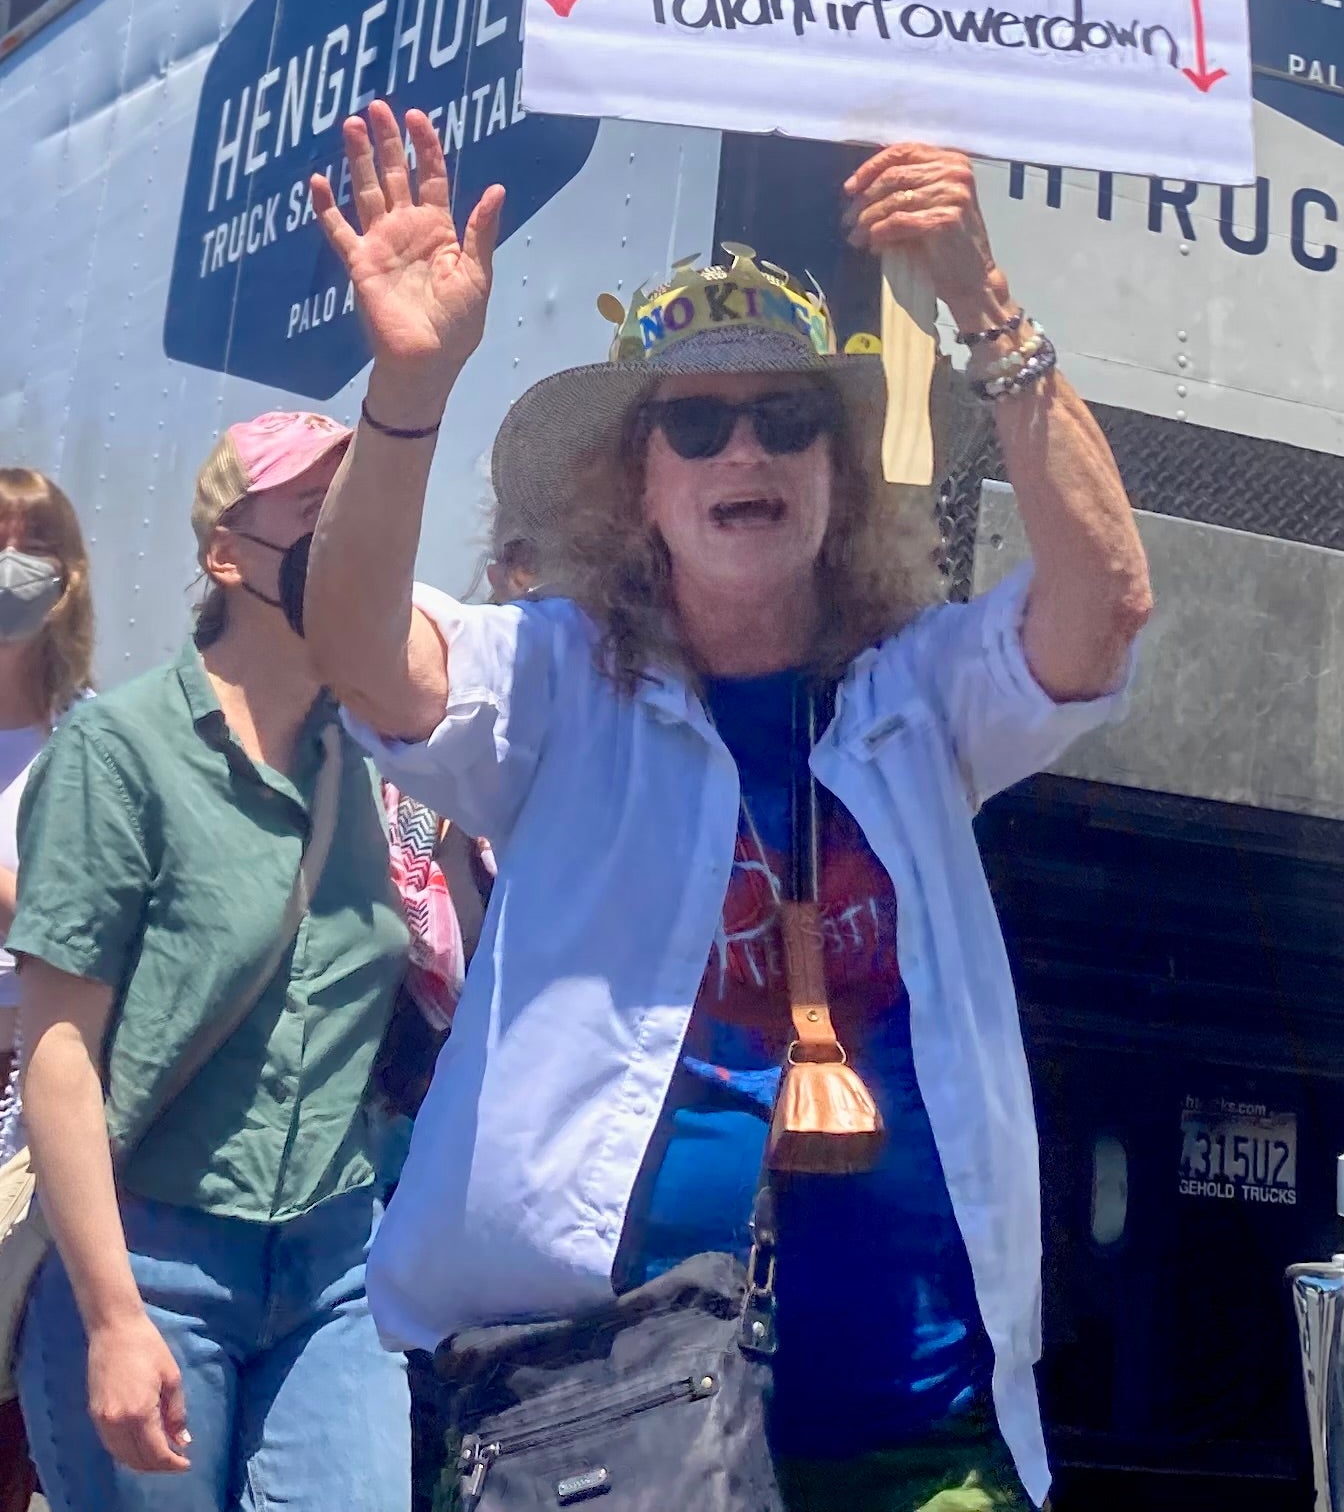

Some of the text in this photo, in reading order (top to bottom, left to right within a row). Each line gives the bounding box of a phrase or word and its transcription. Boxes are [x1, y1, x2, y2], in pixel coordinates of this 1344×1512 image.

[199, 192, 283, 279] TRUCK
[286, 286, 336, 340] PALO
[639, 296, 695, 351] NO
[1241, 1185, 1297, 1205] TRUCKS
